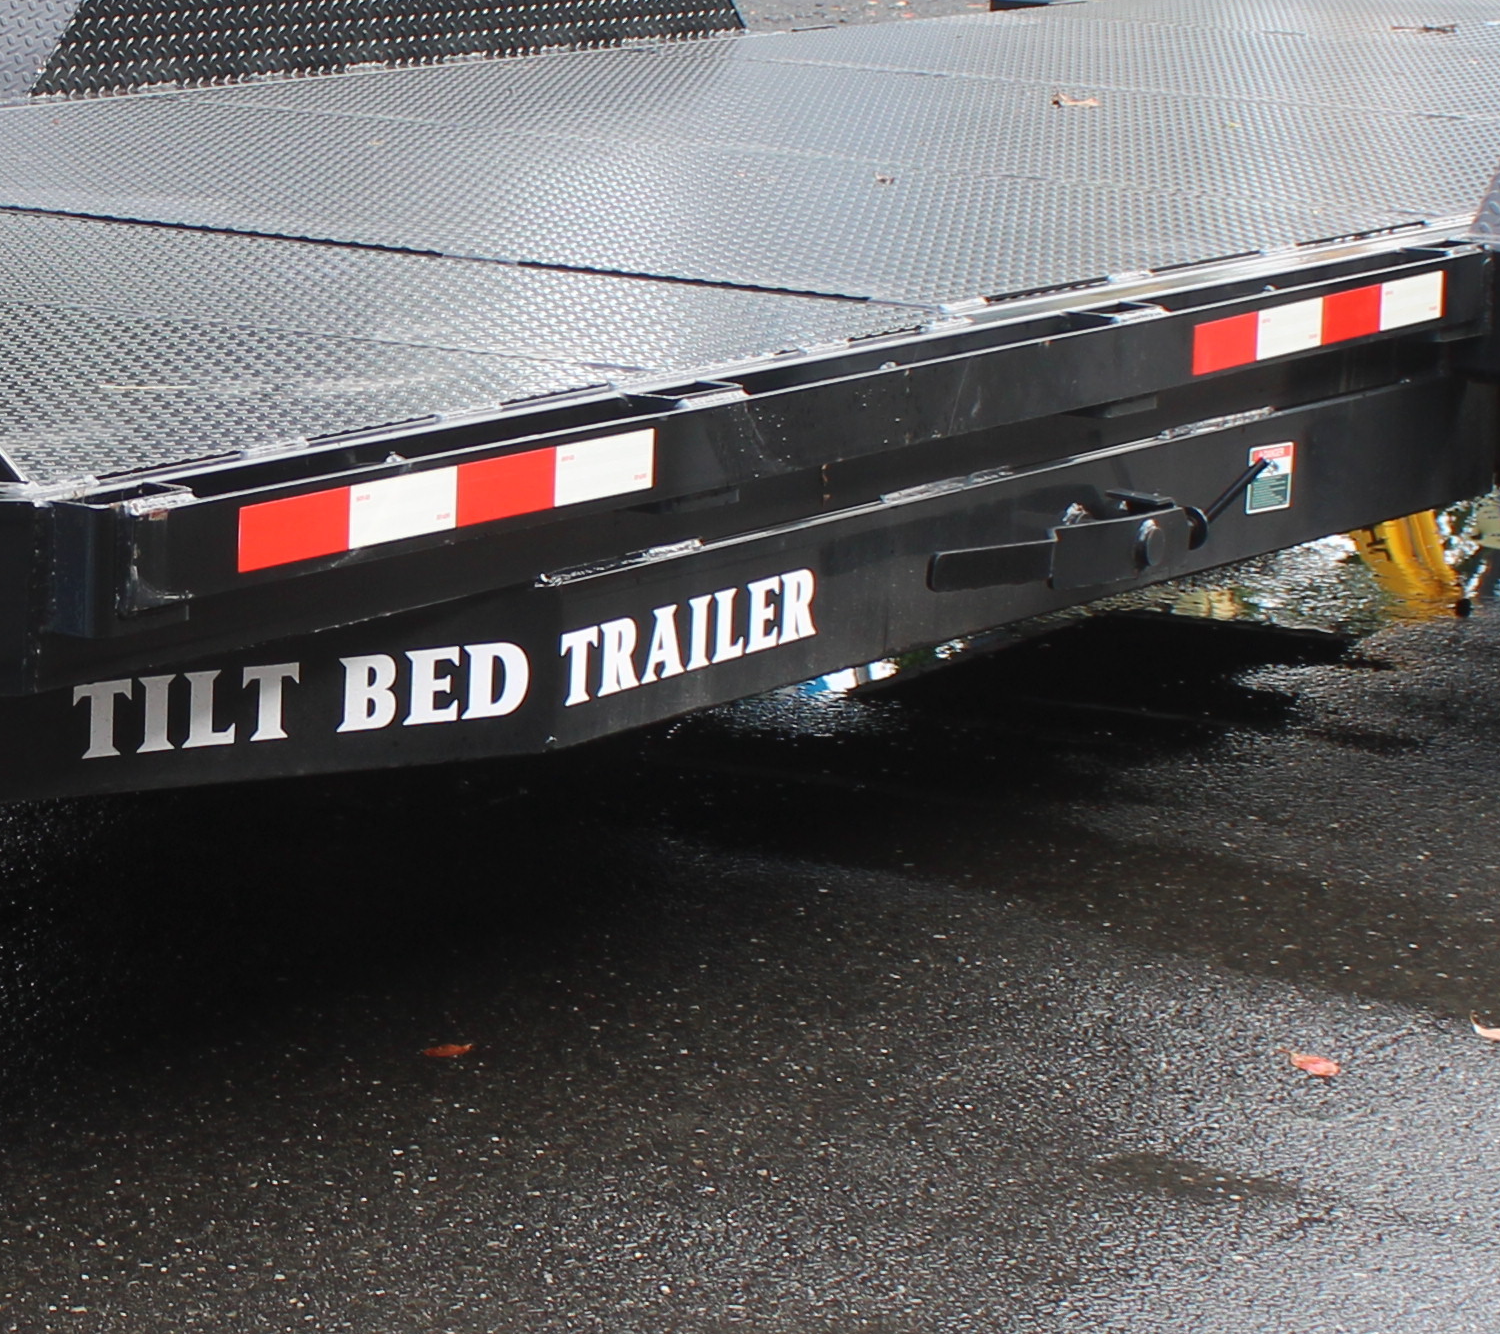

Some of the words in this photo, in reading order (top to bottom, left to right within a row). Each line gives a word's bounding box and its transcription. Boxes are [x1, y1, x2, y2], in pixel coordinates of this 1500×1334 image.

[73, 662, 299, 759] TILT
[336, 641, 530, 733] BED
[560, 569, 817, 707] TRAILER
